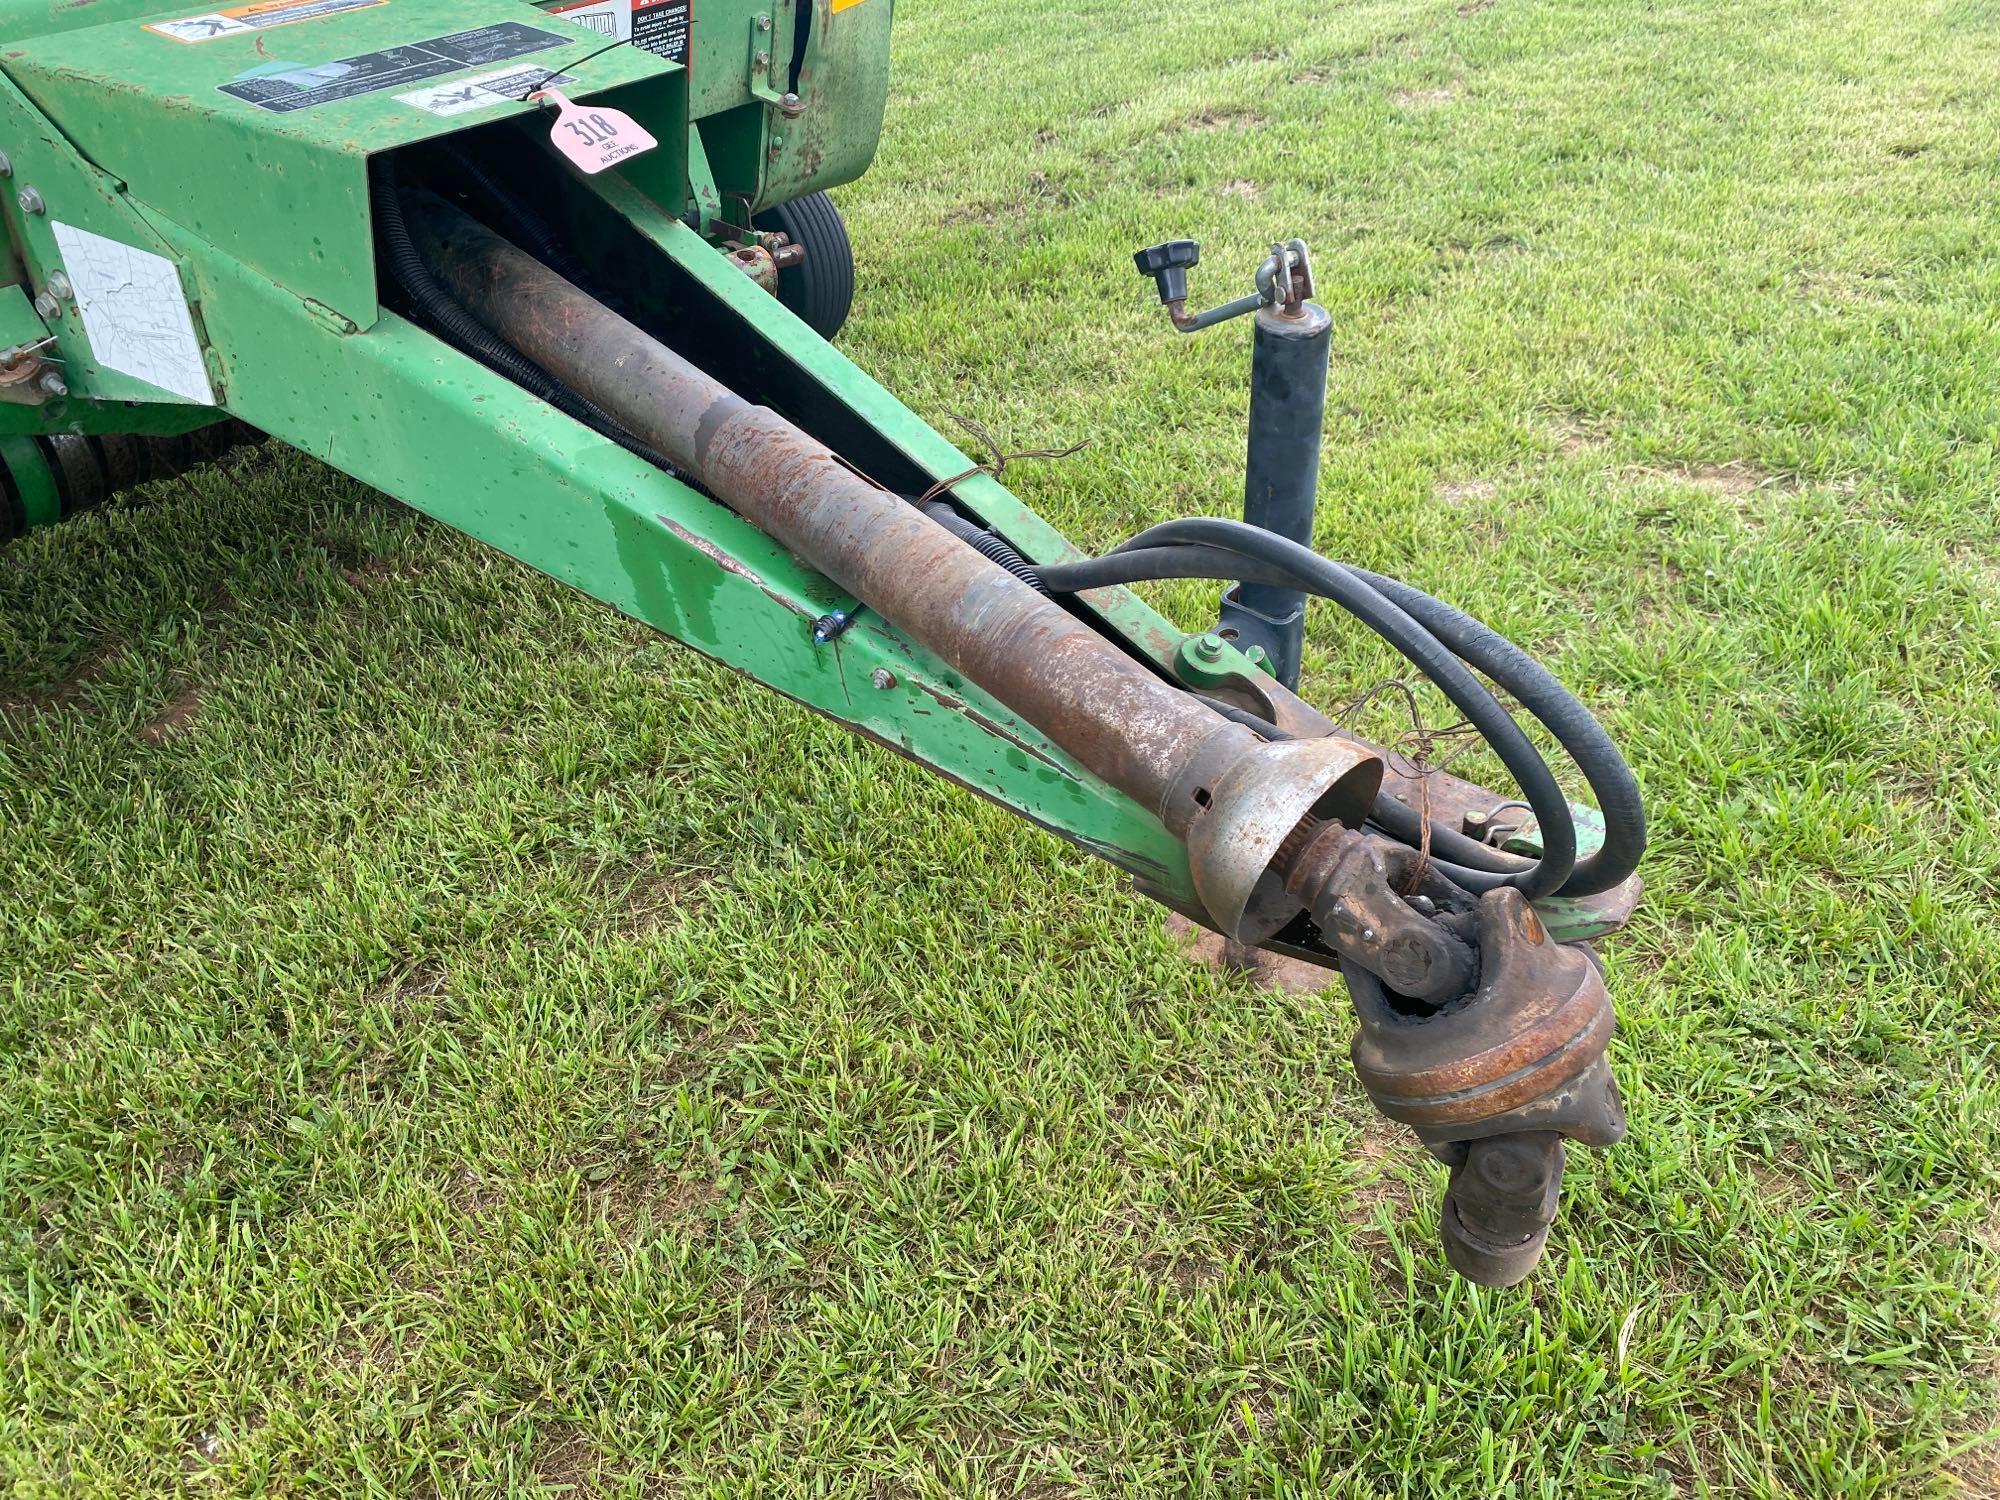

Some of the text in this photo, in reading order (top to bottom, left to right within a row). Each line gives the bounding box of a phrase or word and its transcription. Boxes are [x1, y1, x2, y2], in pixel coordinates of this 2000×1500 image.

[637, 14, 652, 23] DON'T
[652, 10, 665, 19] TAKE
[648, 34, 662, 42] attempt
[564, 113, 618, 147] 318
[600, 143, 638, 164] AUCTIONS
